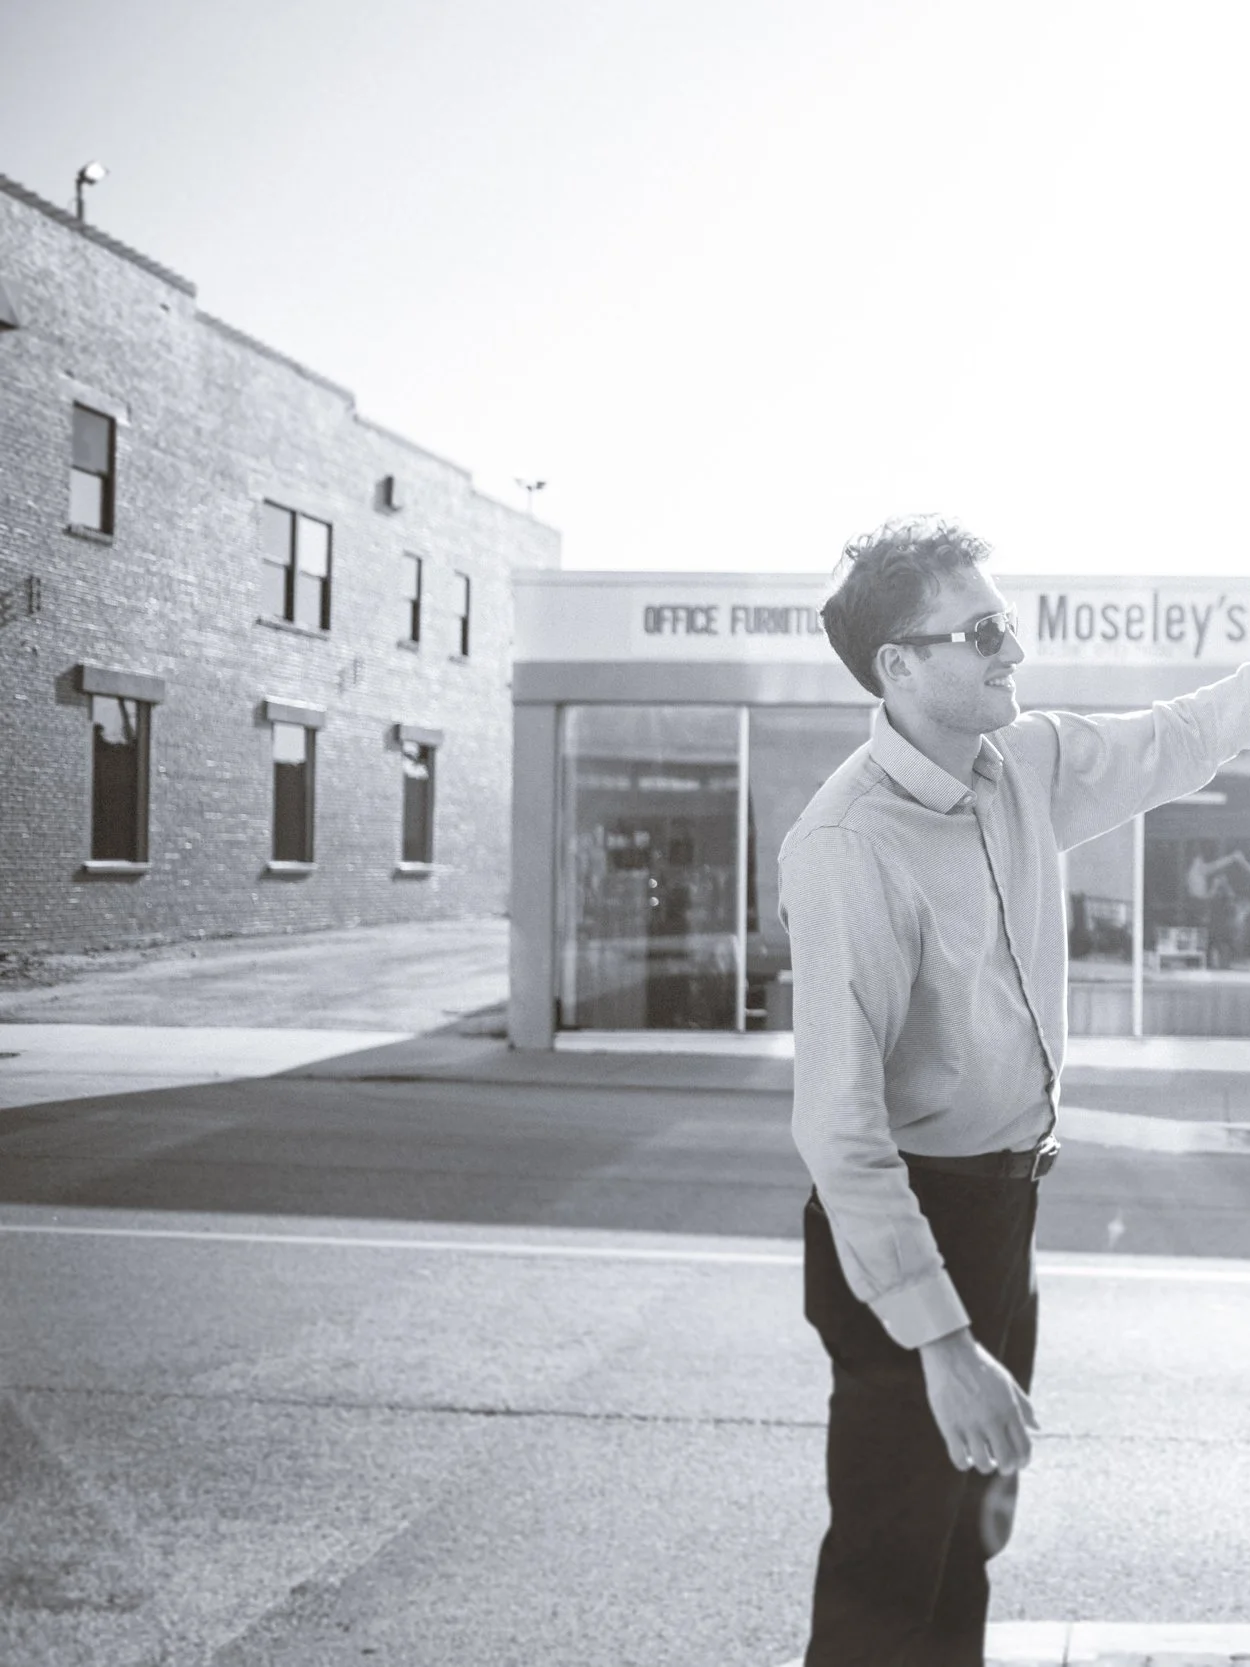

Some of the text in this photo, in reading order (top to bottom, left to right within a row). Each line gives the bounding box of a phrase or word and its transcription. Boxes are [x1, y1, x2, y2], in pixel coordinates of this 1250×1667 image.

[643, 605, 822, 635] OFFICE FURNITU
[1037, 589, 1247, 658] Moseley's
